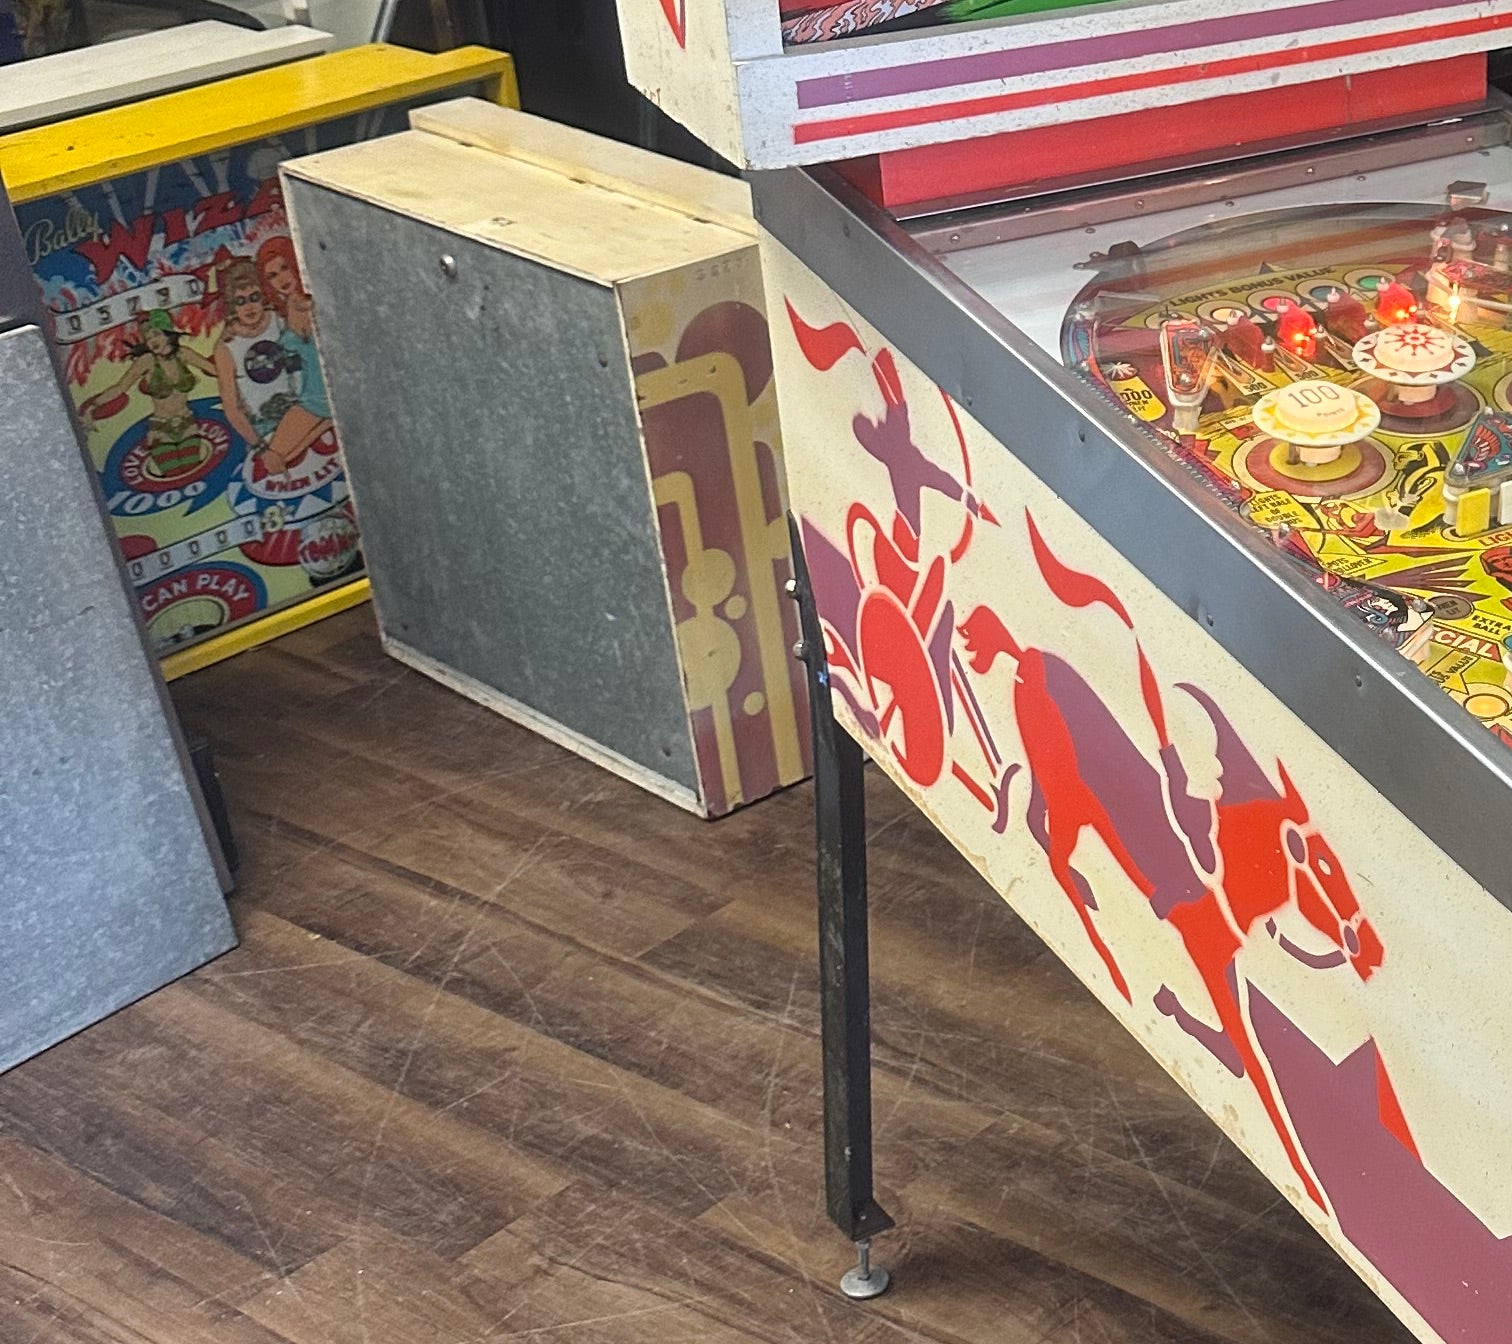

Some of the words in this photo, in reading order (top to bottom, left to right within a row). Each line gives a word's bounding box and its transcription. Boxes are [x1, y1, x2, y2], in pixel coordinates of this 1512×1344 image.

[26, 211, 100, 266] Bally
[1169, 290, 1229, 307] LIGHTS
[1229, 278, 1284, 297] BONUS
[1285, 266, 1337, 282] VALUE
[1243, 382, 1266, 392] 500
[1288, 385, 1340, 409] 100
[200, 422, 230, 453] LOVE
[124, 441, 150, 485] LOVE
[264, 475, 312, 493] WHEN
[315, 460, 342, 482] LIT
[107, 481, 208, 515] 1000
[263, 506, 284, 533] 3
[142, 578, 189, 612] CAN
[196, 573, 250, 602] PLAY
[1472, 623, 1503, 639] BALL
